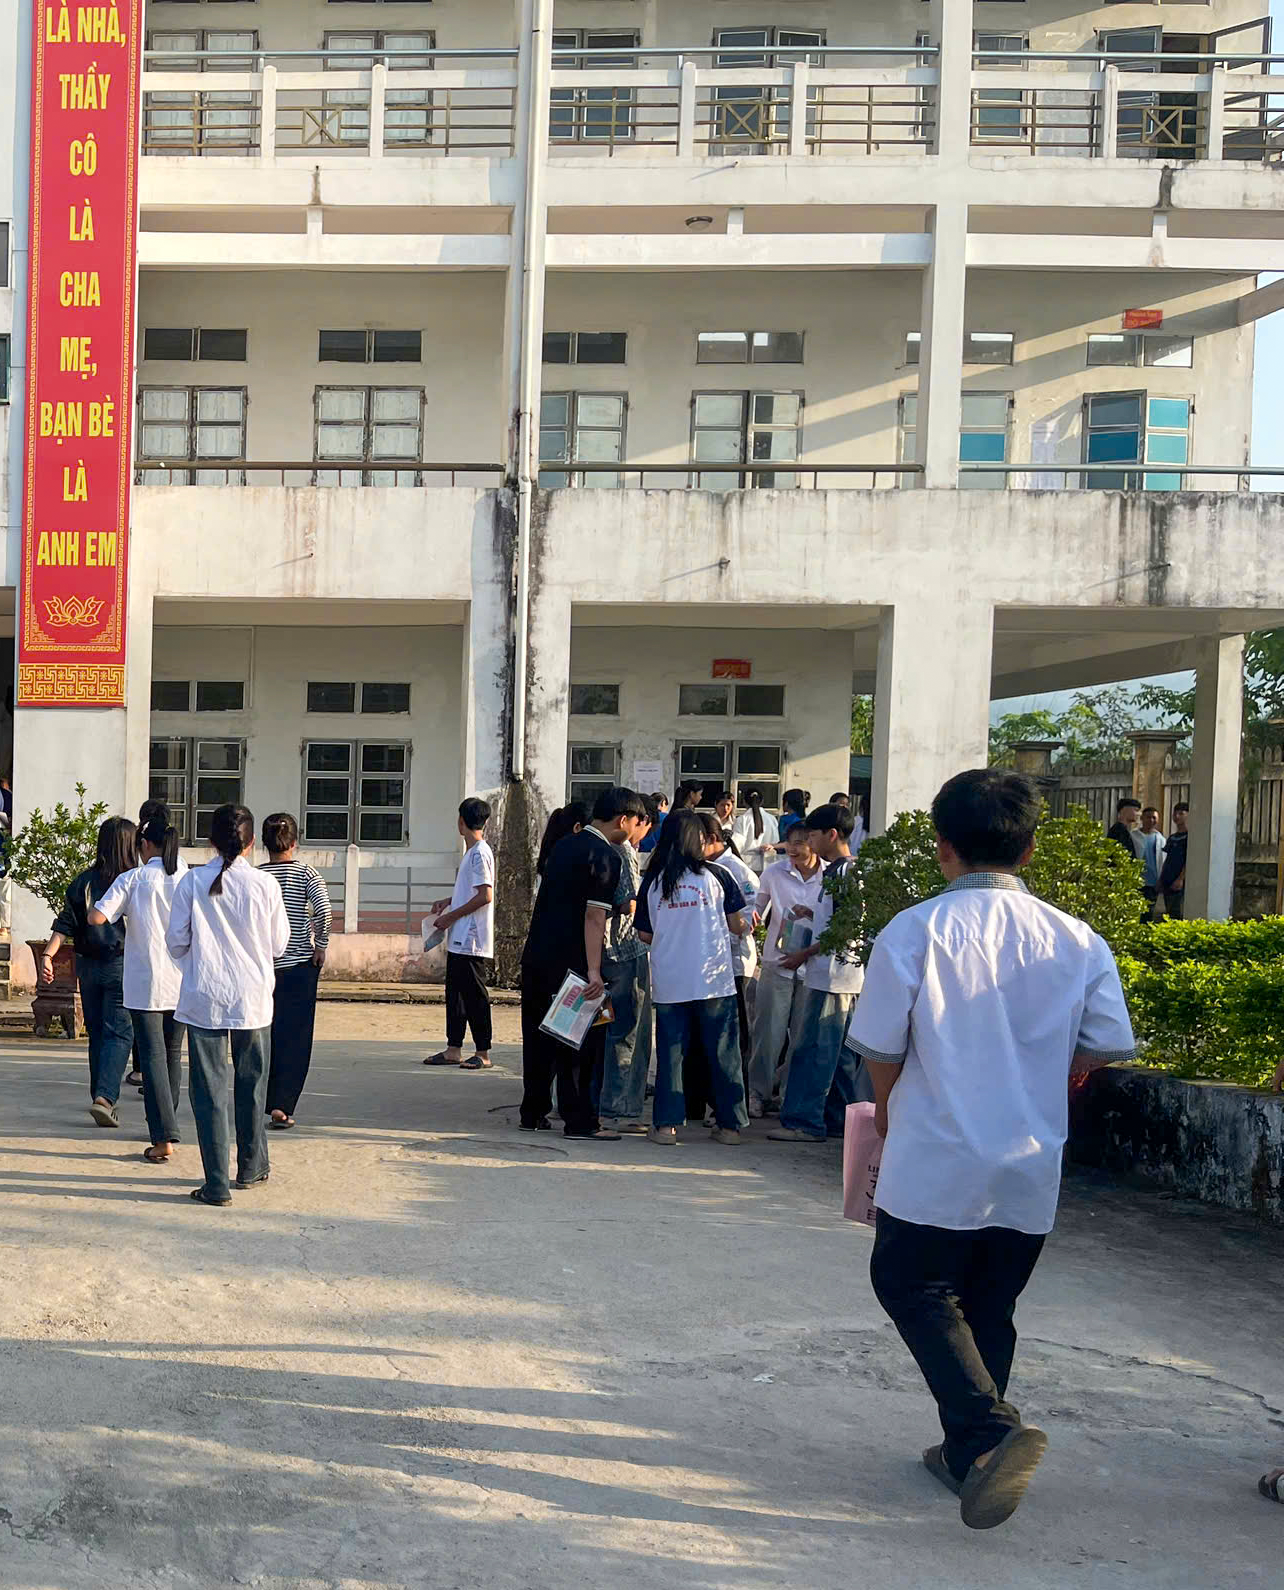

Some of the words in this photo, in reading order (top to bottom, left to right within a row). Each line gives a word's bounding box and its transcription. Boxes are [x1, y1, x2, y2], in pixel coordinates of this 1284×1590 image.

[46, 0, 71, 43] LÀ
[77, 0, 126, 48] NHÀ,
[60, 62, 111, 109] THẦY
[70, 132, 97, 176] CÔ
[70, 198, 94, 240] LÀ
[60, 272, 100, 307] CHA
[60, 337, 97, 380] MẸ,
[40, 402, 82, 444] BẠN
[89, 395, 114, 437] BÈ
[64, 459, 87, 501] LÀ
[37, 532, 79, 566] ANH
[86, 532, 116, 567] EM
